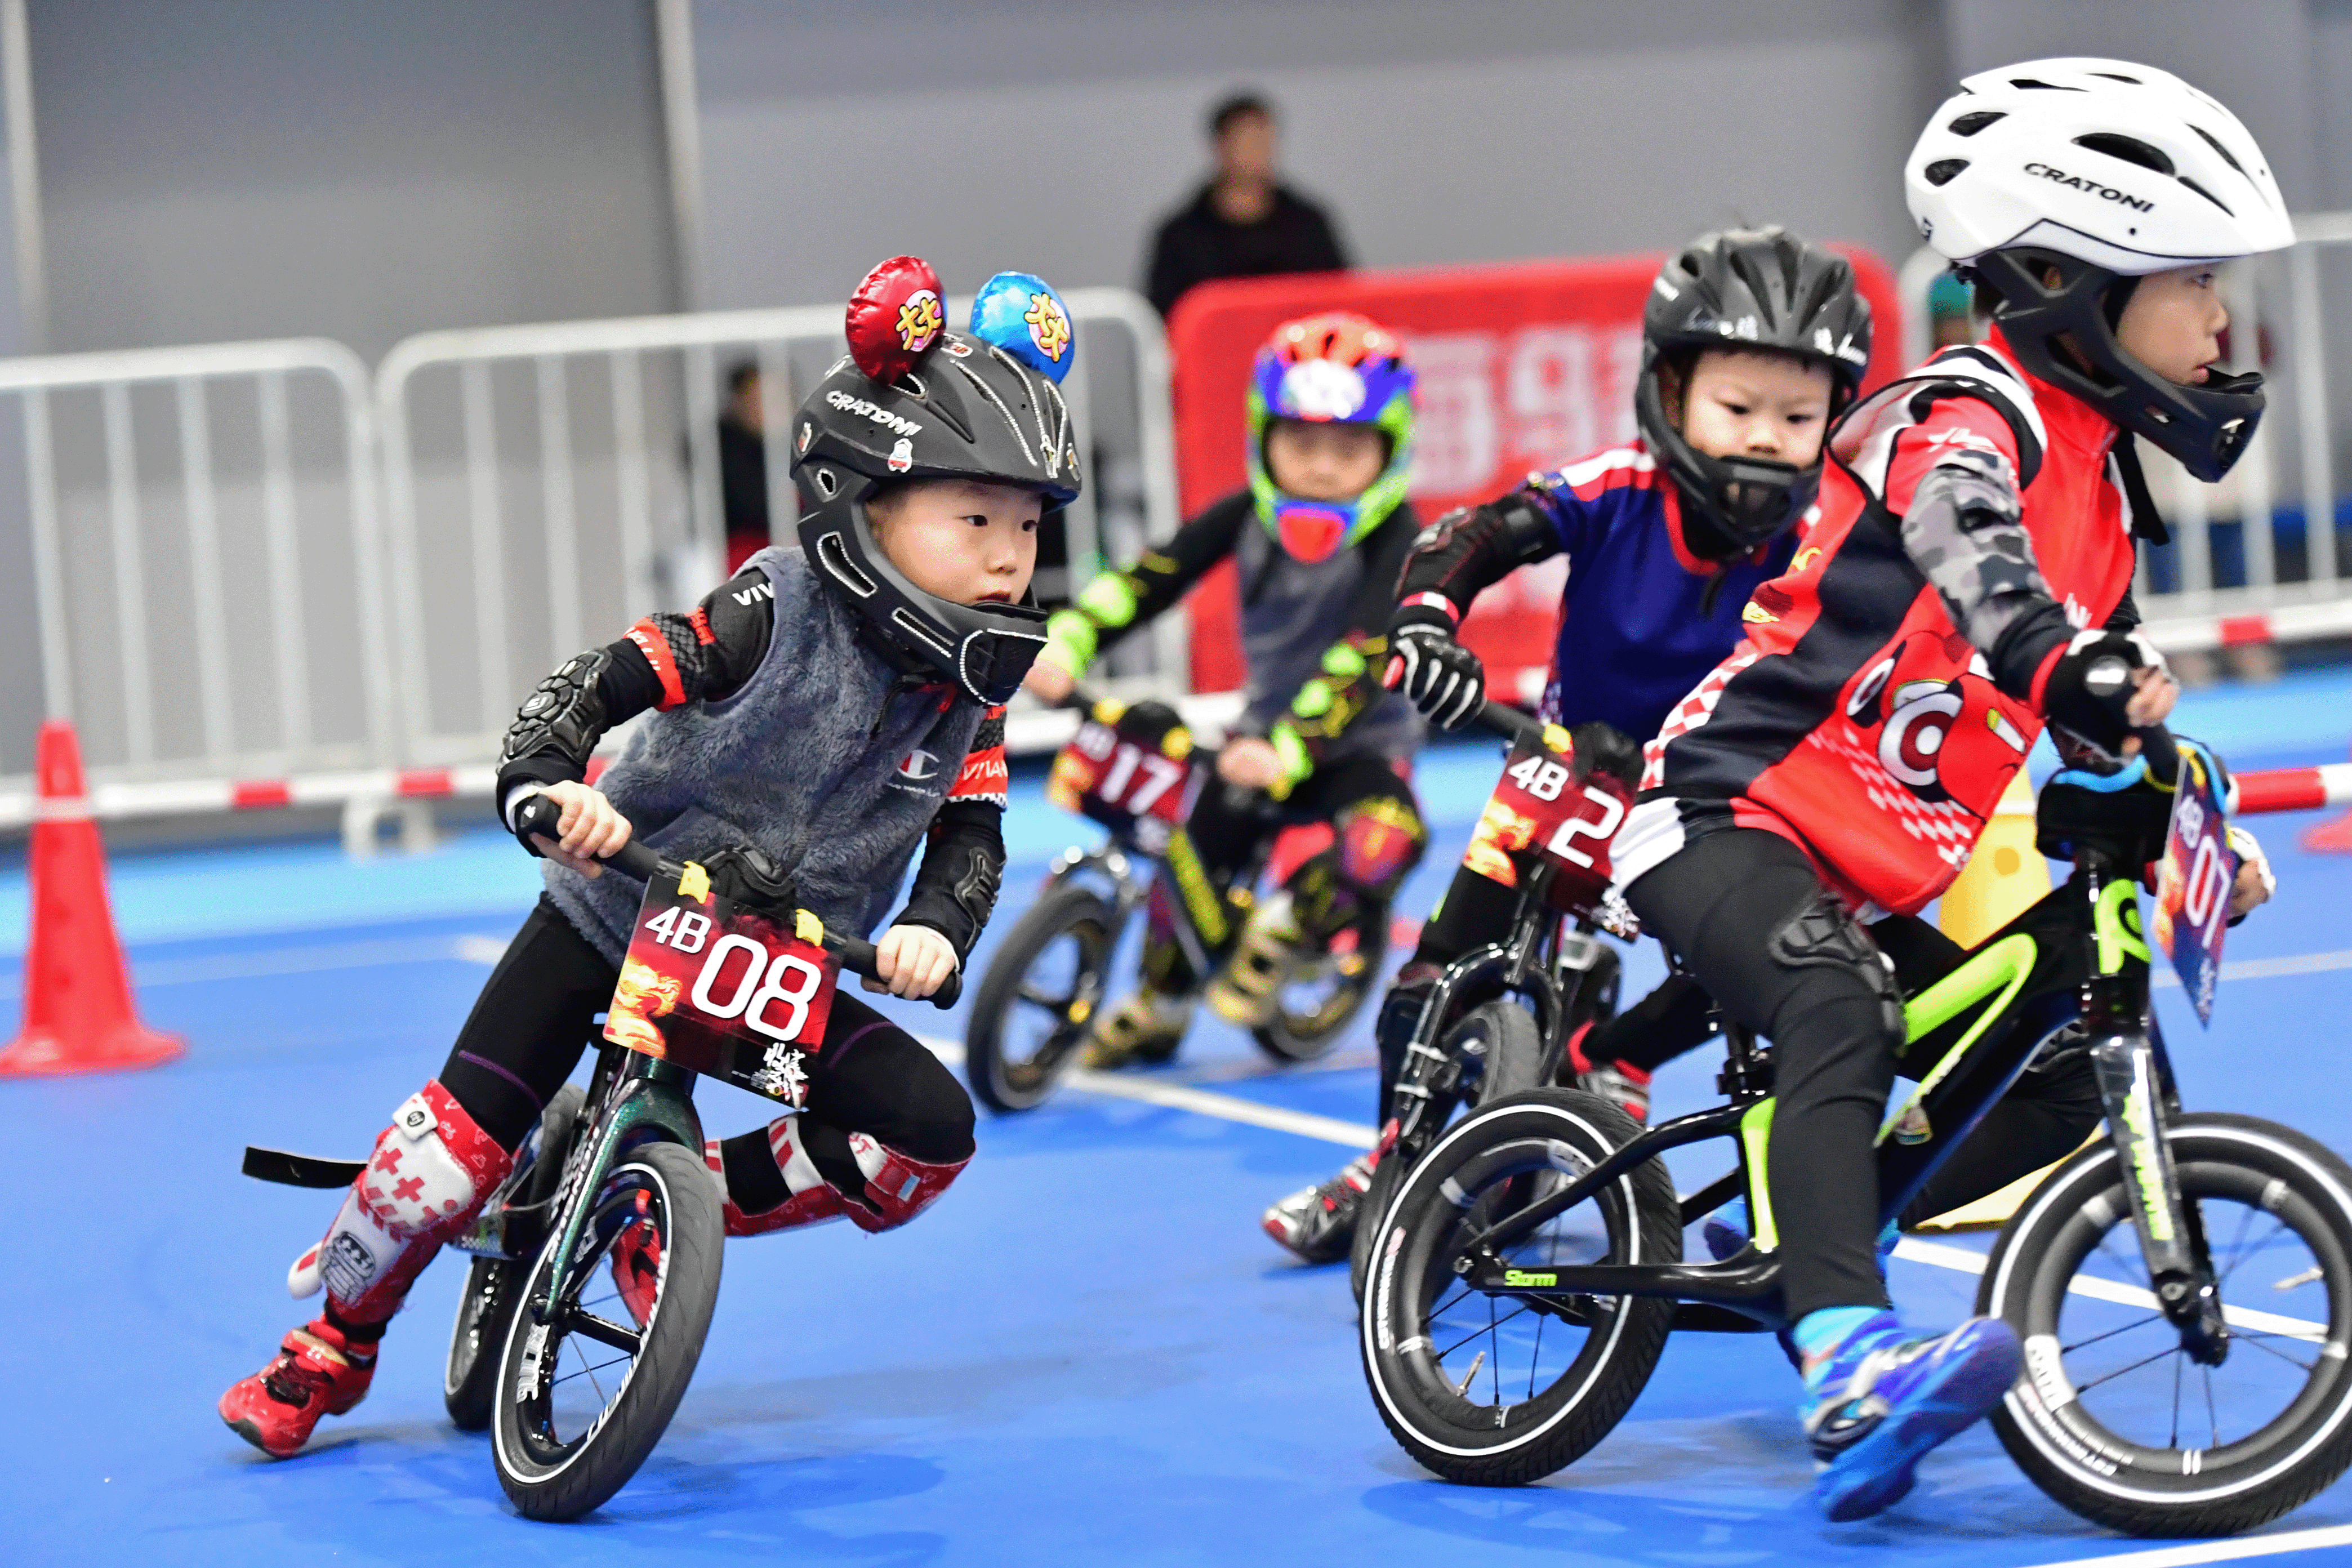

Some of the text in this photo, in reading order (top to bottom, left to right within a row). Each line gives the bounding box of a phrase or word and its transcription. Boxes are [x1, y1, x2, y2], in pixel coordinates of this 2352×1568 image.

[2024, 162, 2155, 213] CRATONI
[826, 390, 922, 436] CRATONI
[1100, 743, 1182, 815] 17
[1508, 755, 1569, 801] 4B
[1547, 786, 1624, 869] 2
[2185, 835, 2231, 949] 07
[645, 906, 712, 954] 4B
[691, 934, 822, 1041] 08
